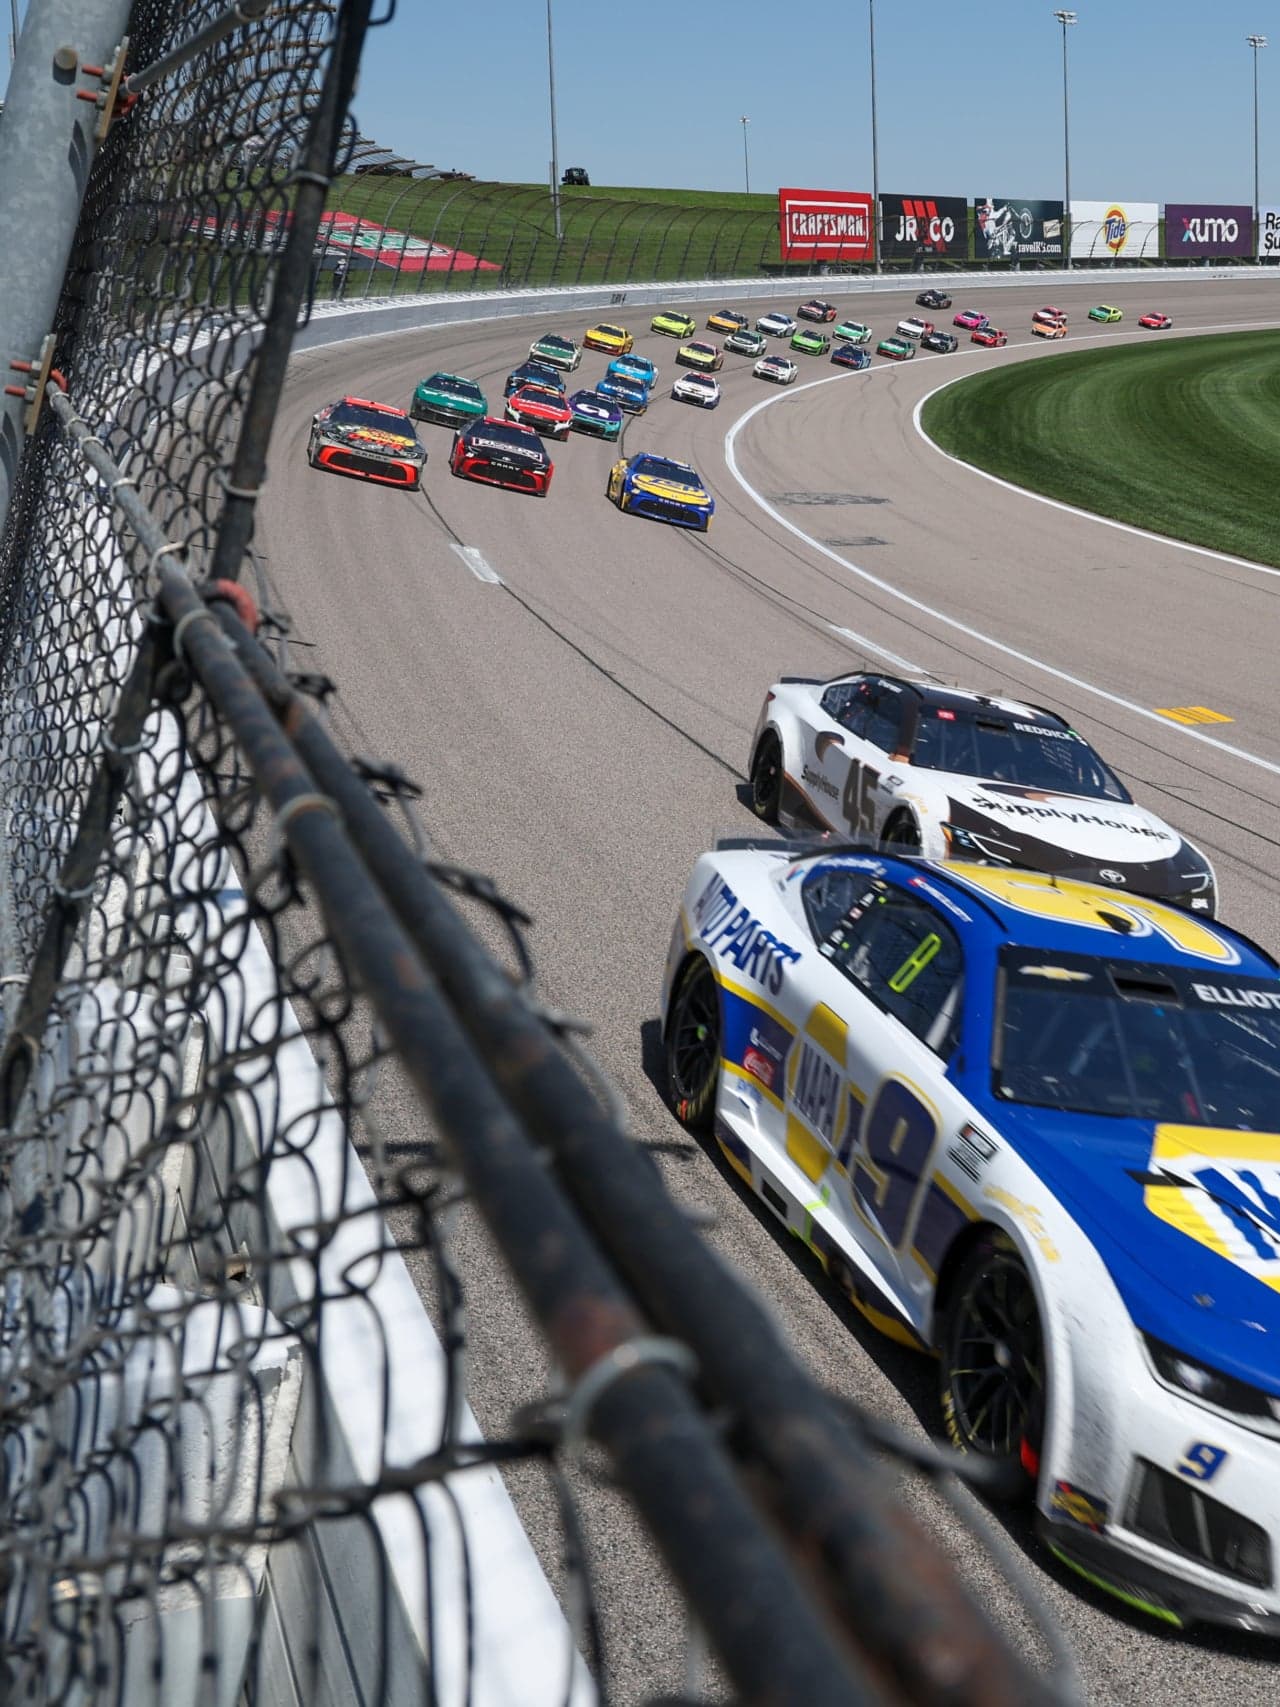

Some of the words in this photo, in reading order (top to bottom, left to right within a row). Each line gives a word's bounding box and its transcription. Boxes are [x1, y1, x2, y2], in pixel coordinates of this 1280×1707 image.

[792, 213, 866, 236] CRAFTSMAN
[1105, 218, 1127, 245] Tide
[1013, 721, 1074, 741] REDDICK
[972, 796, 1172, 841] SupplyHouse
[709, 906, 802, 996] PARTS
[853, 1073, 942, 1255] 9
[1176, 1440, 1229, 1483] 9
